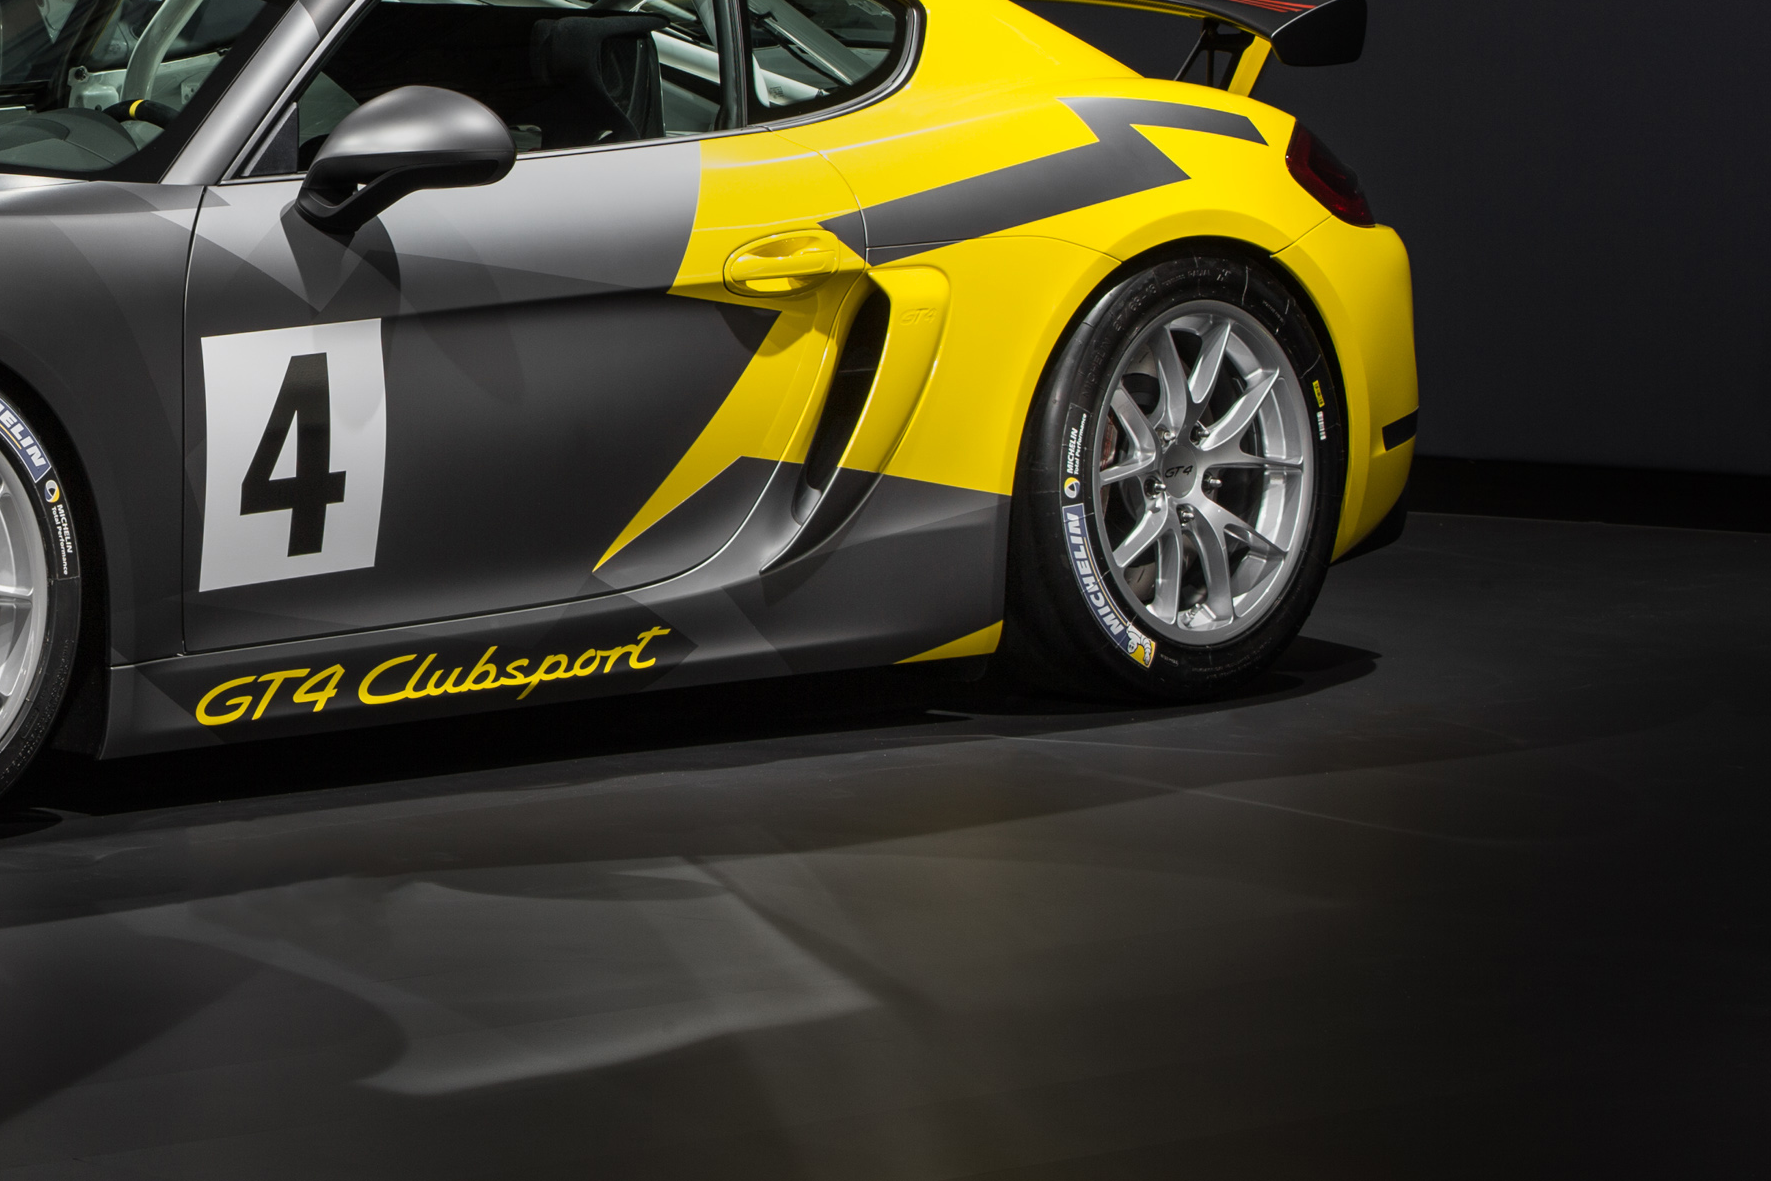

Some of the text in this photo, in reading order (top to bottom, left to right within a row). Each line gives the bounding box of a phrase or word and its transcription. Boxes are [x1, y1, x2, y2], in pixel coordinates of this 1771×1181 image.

[240, 352, 347, 557] 4
[1066, 427, 1078, 474] MICHELIN
[51, 506, 68, 575] Total Performance
[57, 504, 73, 554] MICHELIN
[1067, 512, 1124, 635] MICHELIN
[196, 626, 671, 726] GT4 Clubsport
